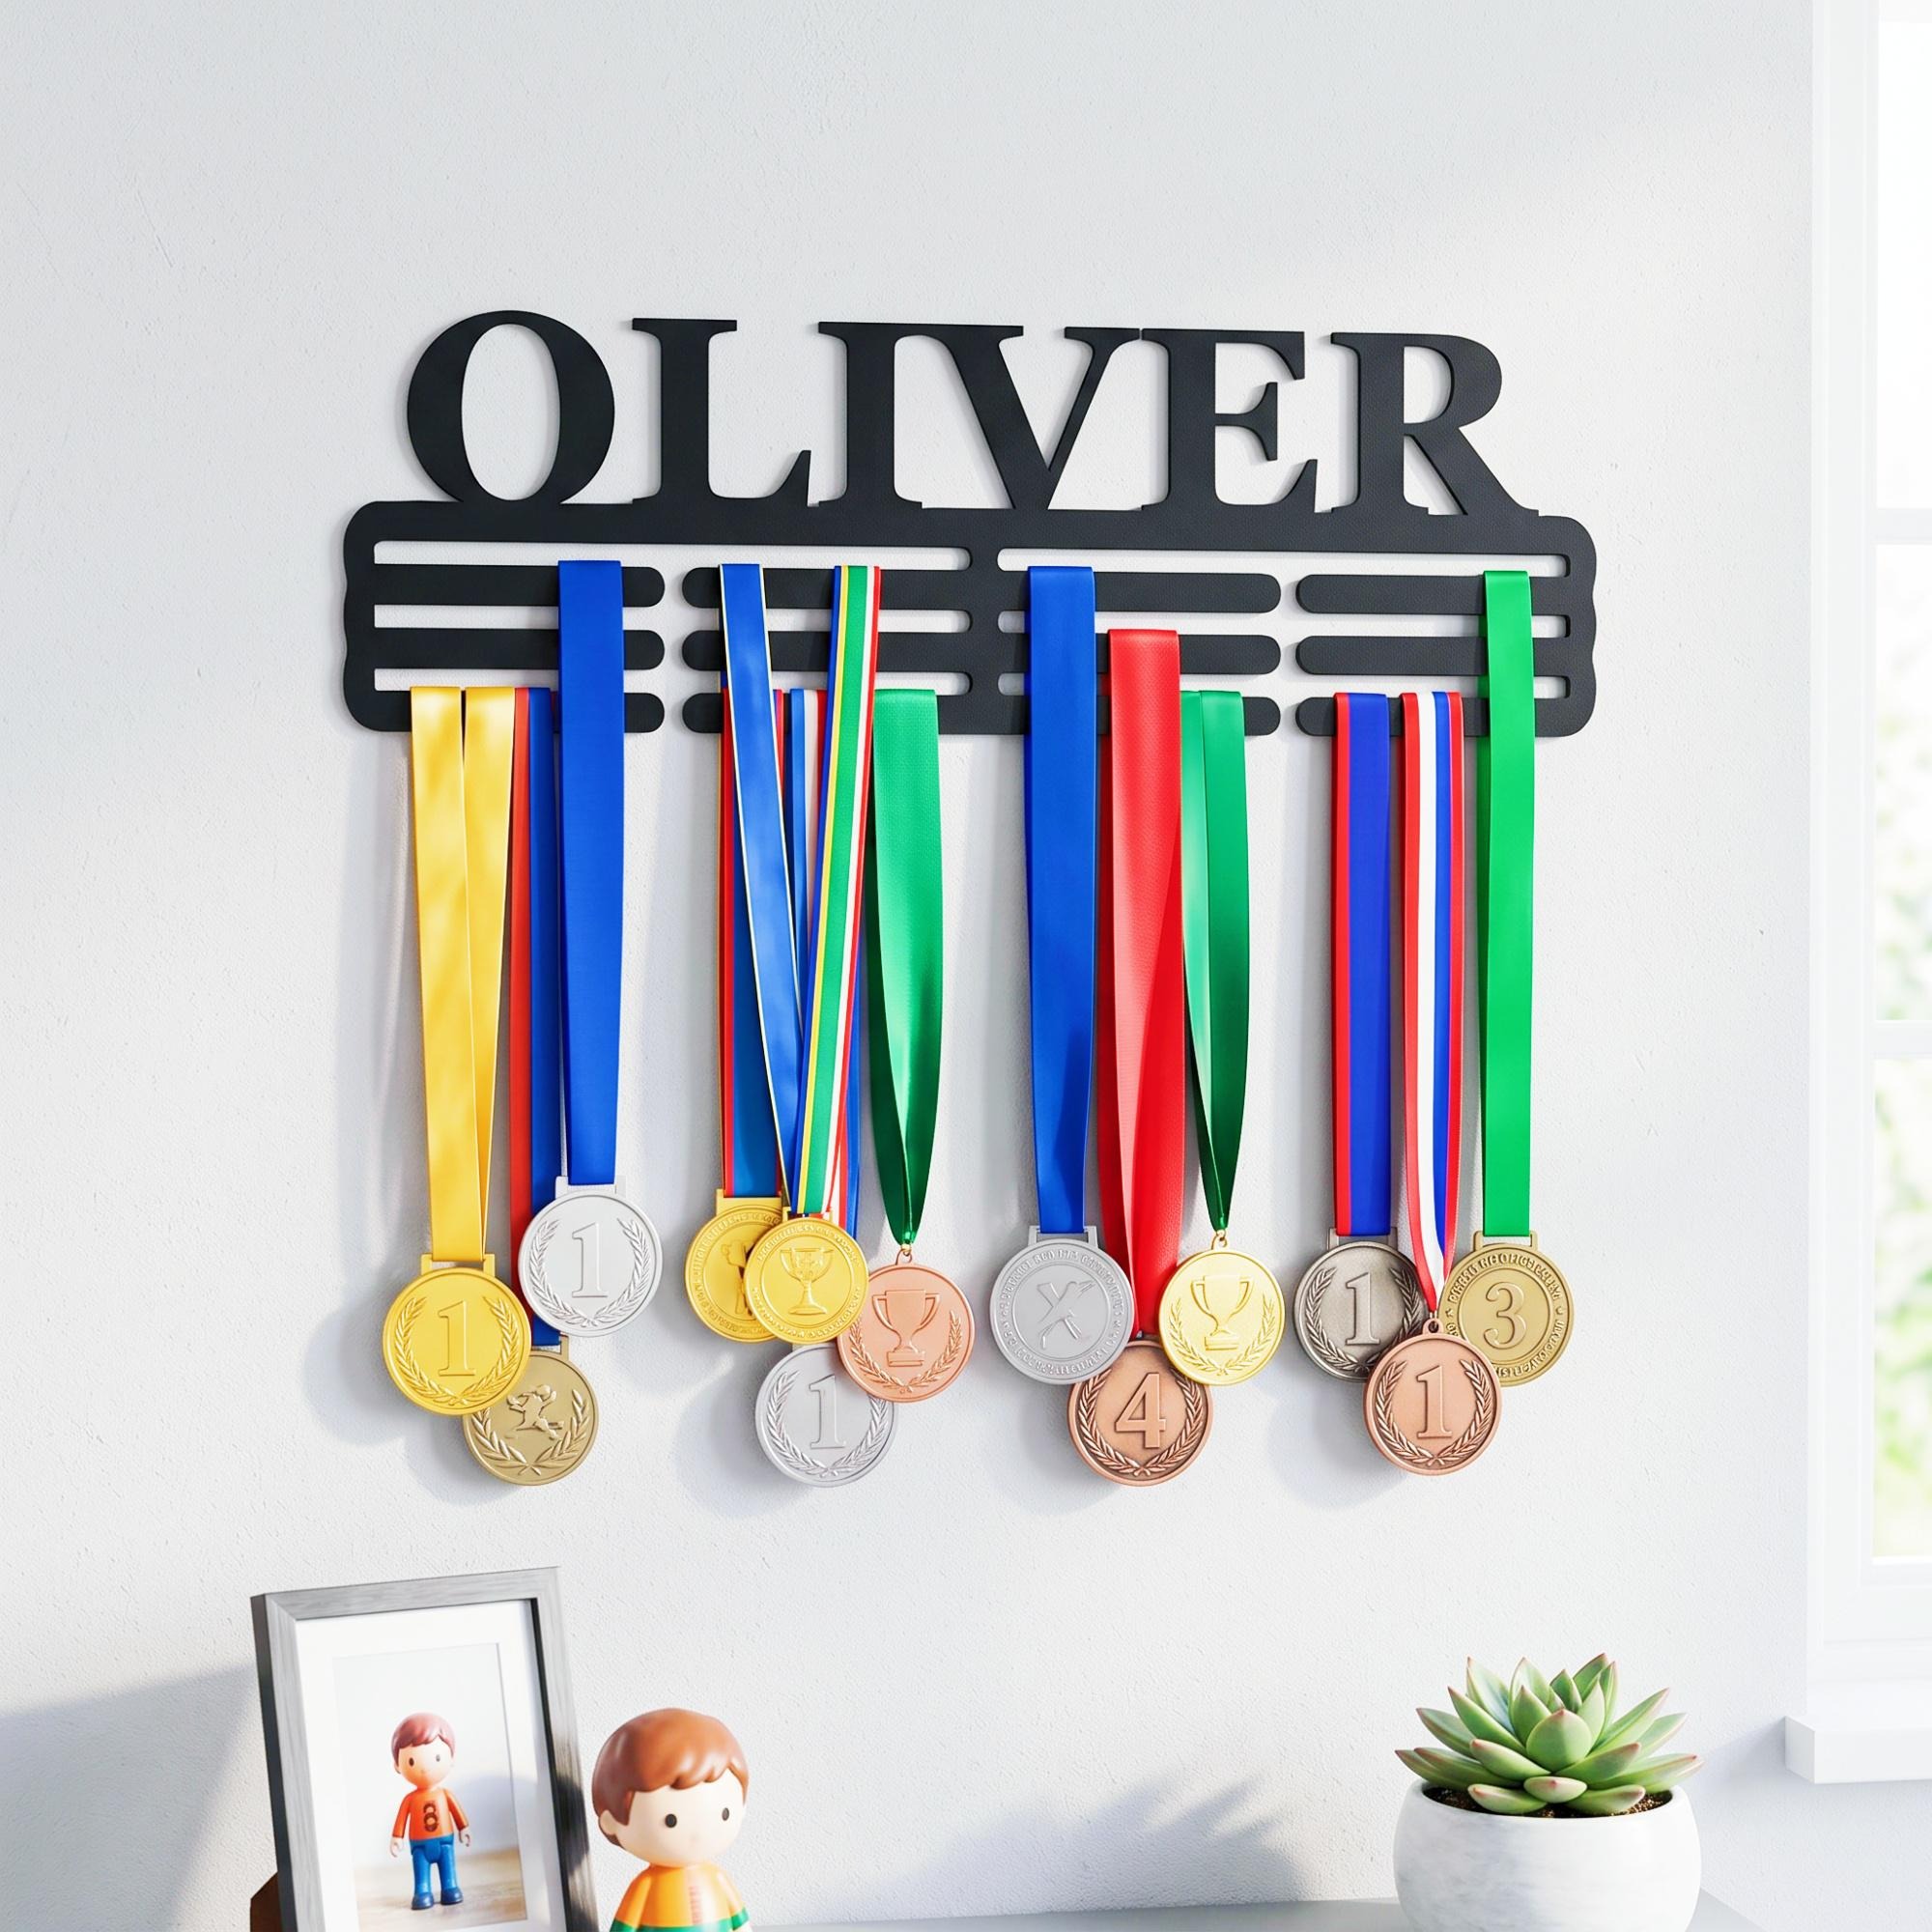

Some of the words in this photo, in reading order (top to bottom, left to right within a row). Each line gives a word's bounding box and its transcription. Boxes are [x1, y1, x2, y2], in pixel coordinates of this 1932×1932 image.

[407, 309, 1540, 517] OLIVER
[571, 1222, 609, 1298] 1
[438, 1300, 476, 1377] 1
[1344, 1272, 1381, 1346] 1
[1483, 1281, 1526, 1350] 3
[808, 1374, 846, 1449] 1
[1115, 1372, 1167, 1449] 4
[1416, 1365, 1454, 1438] 1
